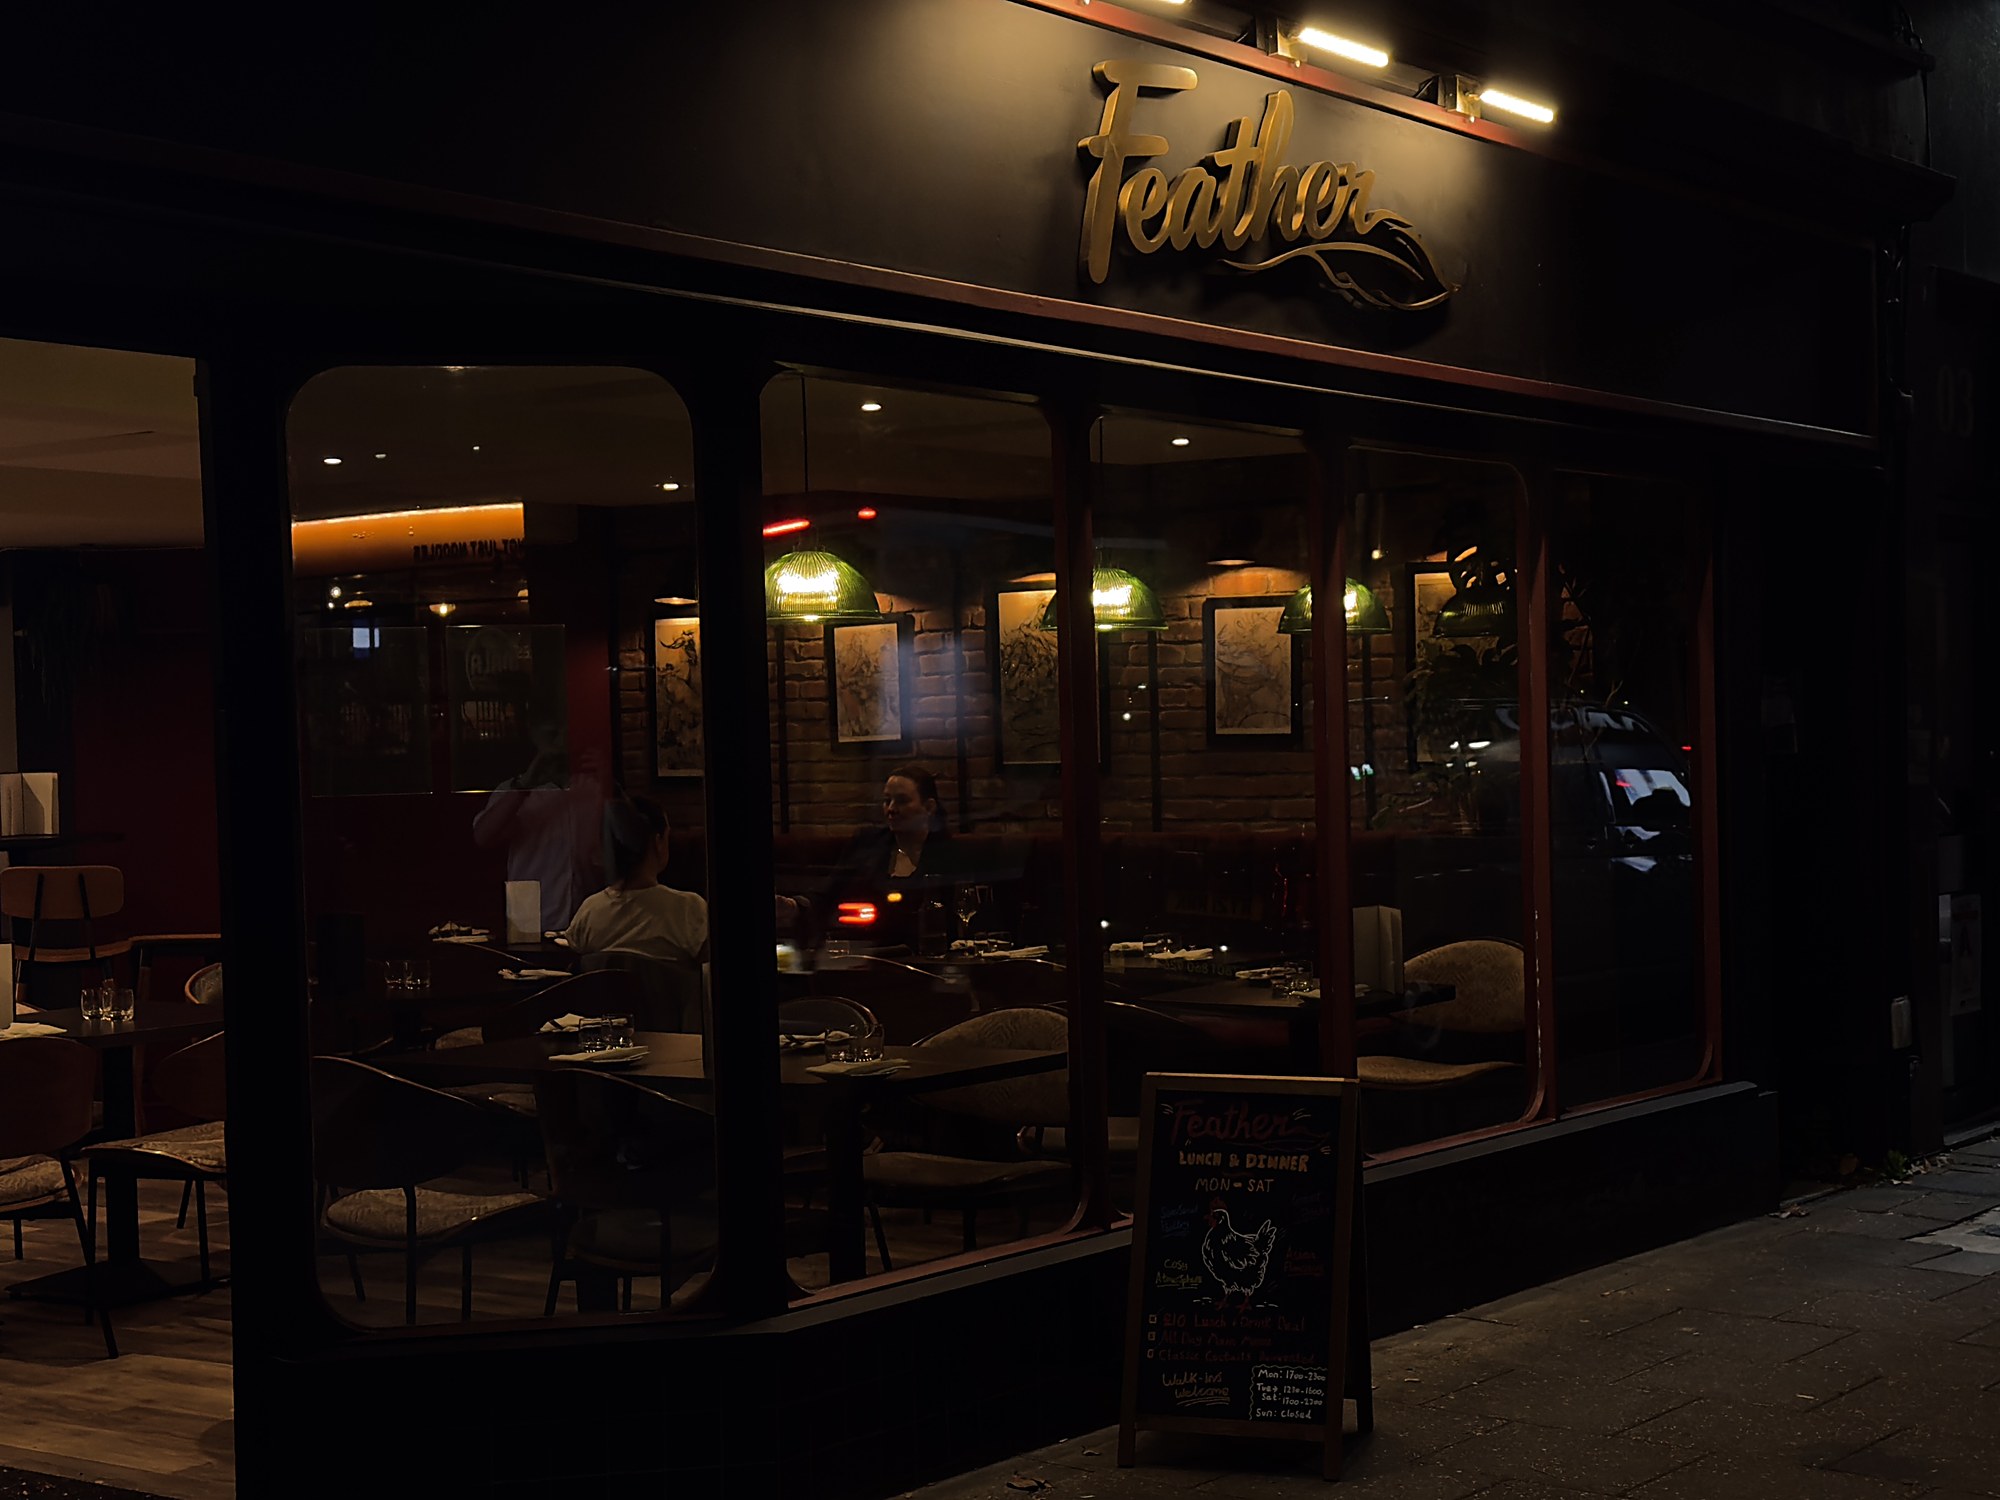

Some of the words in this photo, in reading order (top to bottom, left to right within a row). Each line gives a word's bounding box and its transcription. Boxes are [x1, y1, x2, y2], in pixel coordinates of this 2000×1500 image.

[1077, 59, 1386, 284] Feather
[1170, 1098, 1290, 1146] Feather
[1178, 1150, 1222, 1168] LUNCH
[1229, 1154, 1240, 1168] &
[1245, 1152, 1312, 1173] DINNER
